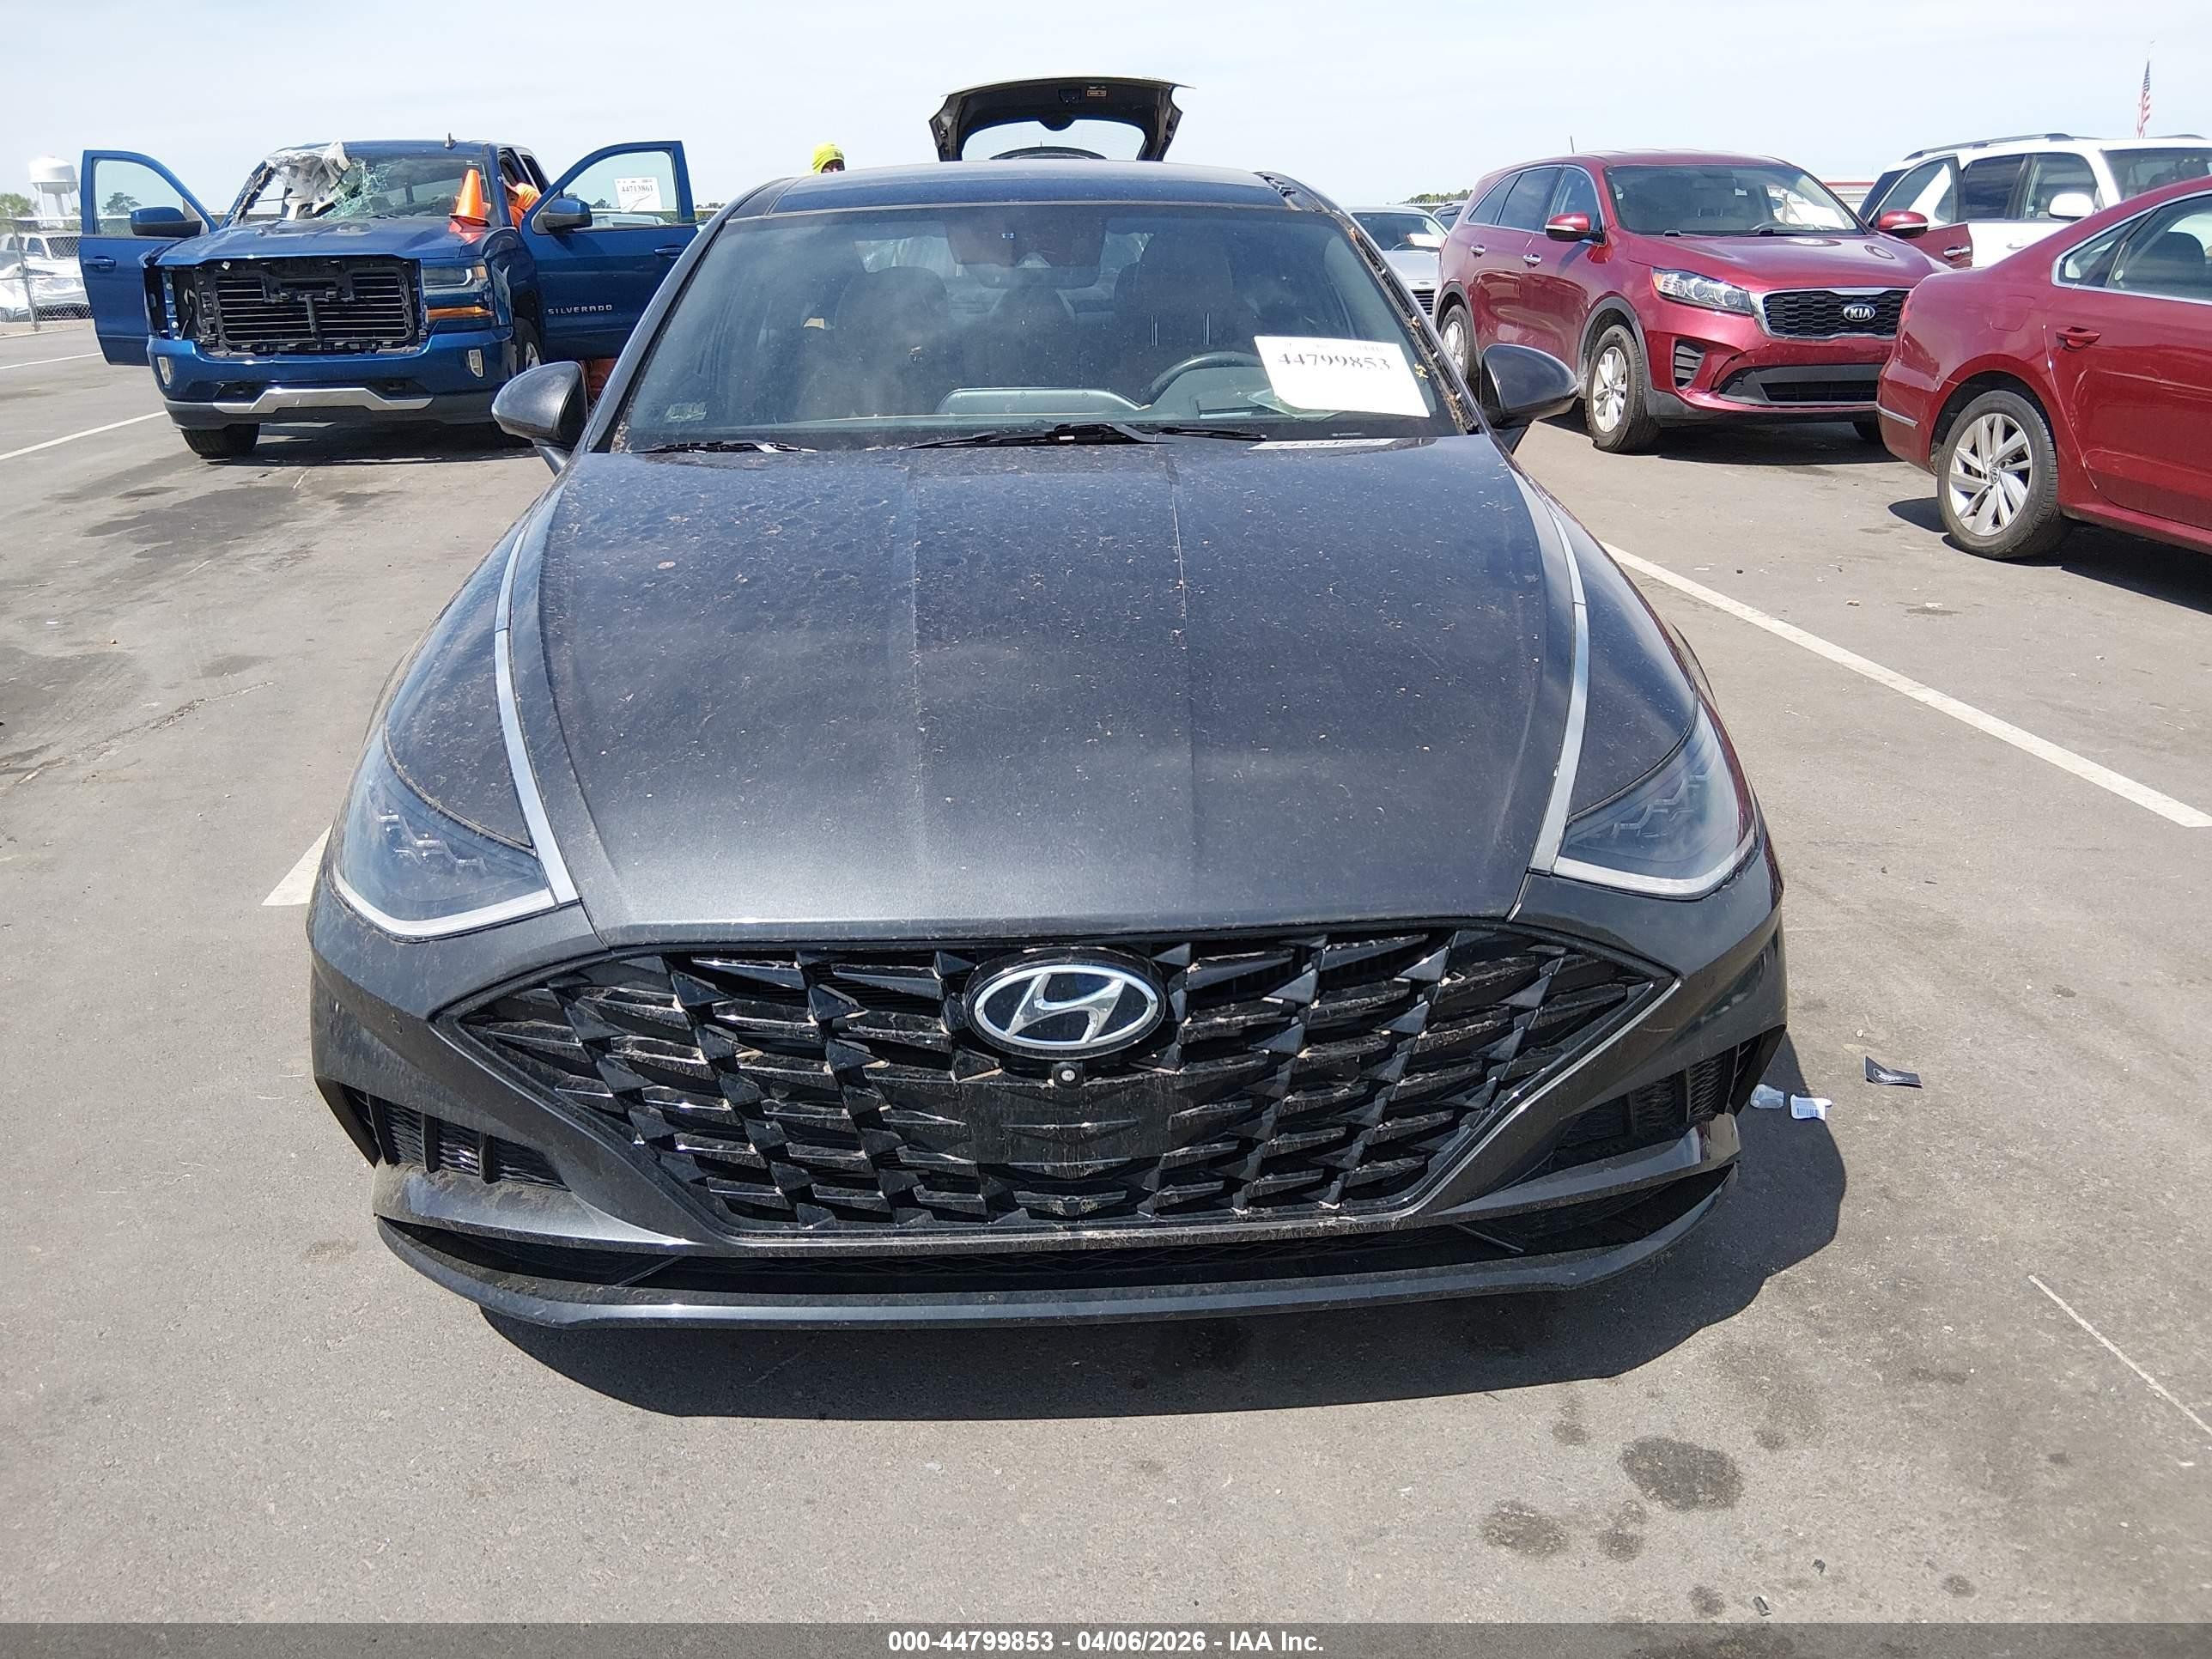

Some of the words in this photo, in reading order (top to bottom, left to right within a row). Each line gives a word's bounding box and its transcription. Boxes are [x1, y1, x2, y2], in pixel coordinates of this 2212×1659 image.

[548, 305, 612, 314] SILVERADO
[1850, 308, 1870, 318] KIA
[1278, 353, 1390, 370] 44799853
